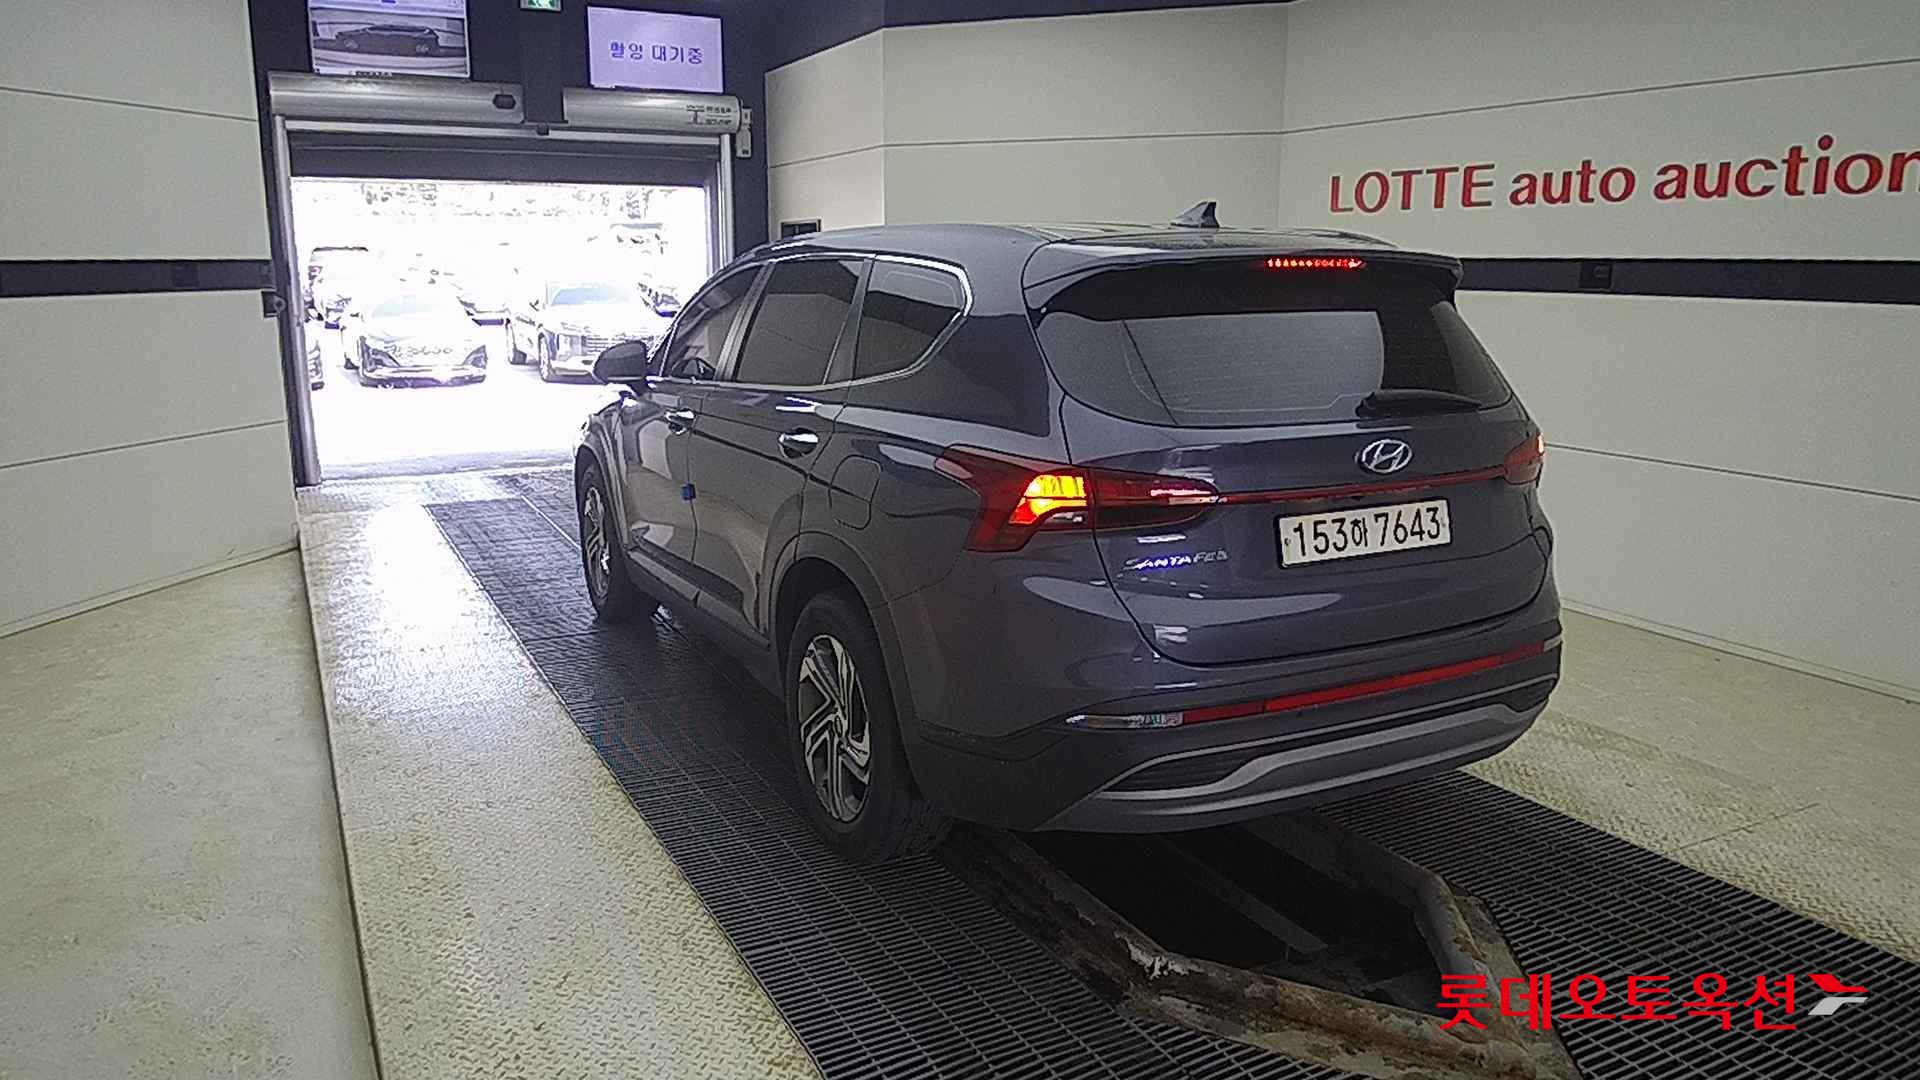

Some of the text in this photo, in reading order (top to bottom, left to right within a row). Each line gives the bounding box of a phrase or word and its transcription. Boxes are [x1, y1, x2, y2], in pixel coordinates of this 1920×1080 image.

[652, 44, 703, 65] 대기중
[1330, 164, 1495, 213] LOTTE
[1509, 159, 1636, 206] auto
